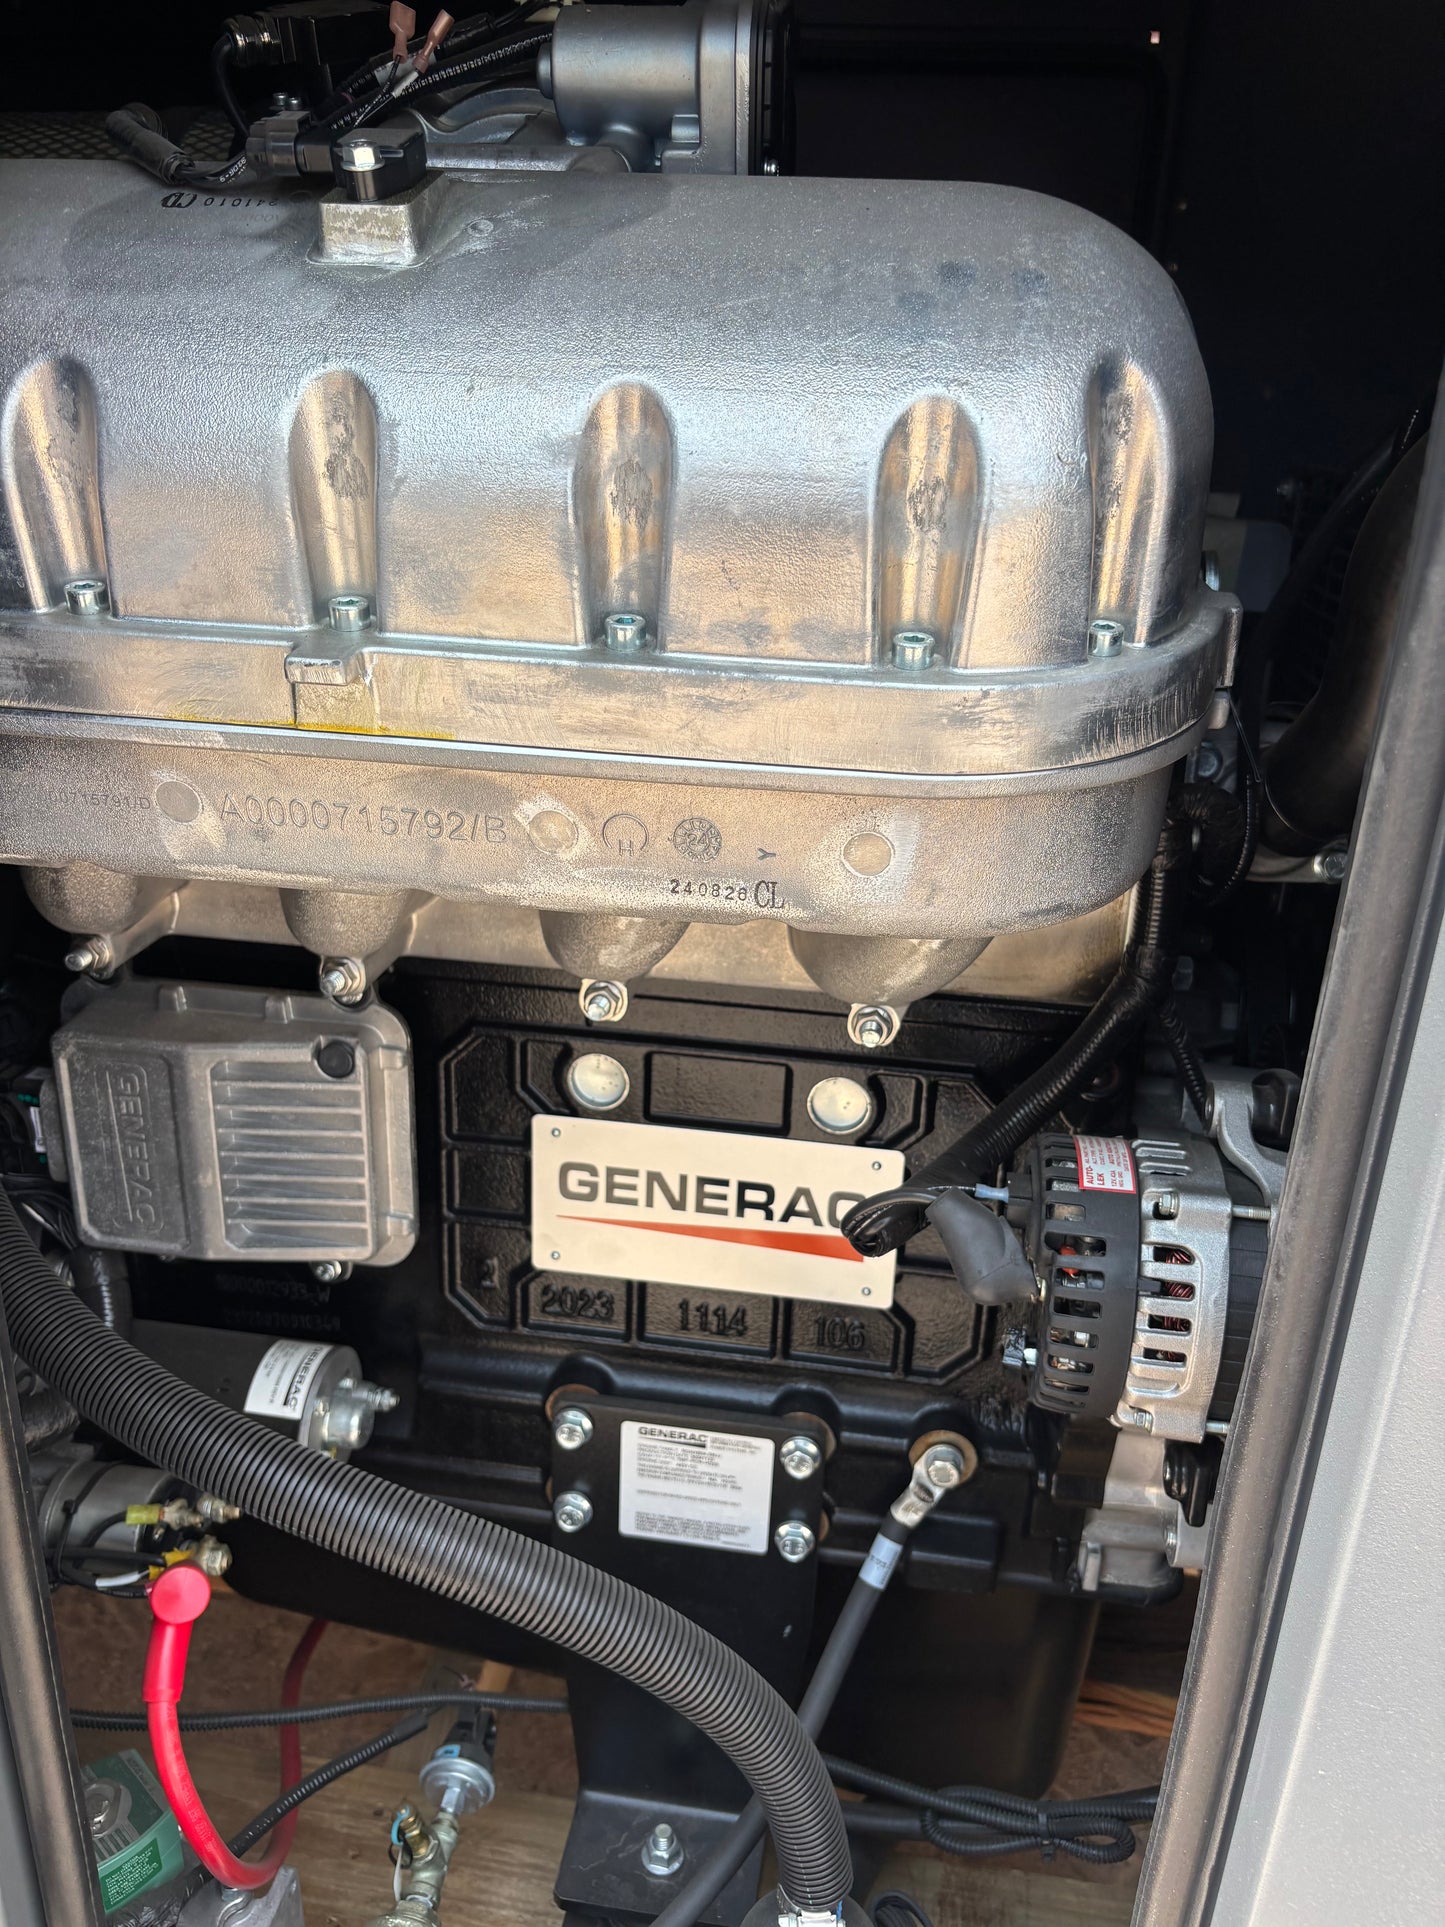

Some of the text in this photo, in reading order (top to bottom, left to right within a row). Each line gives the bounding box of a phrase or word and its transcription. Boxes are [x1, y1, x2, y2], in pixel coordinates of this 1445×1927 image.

[219, 793, 509, 845] A0000715792/B
[669, 878, 748, 902] 240828
[540, 1284, 615, 1321] 2023
[678, 1299, 749, 1338] 1114
[815, 1313, 866, 1351] 106
[637, 1426, 709, 1443] GENERAC
